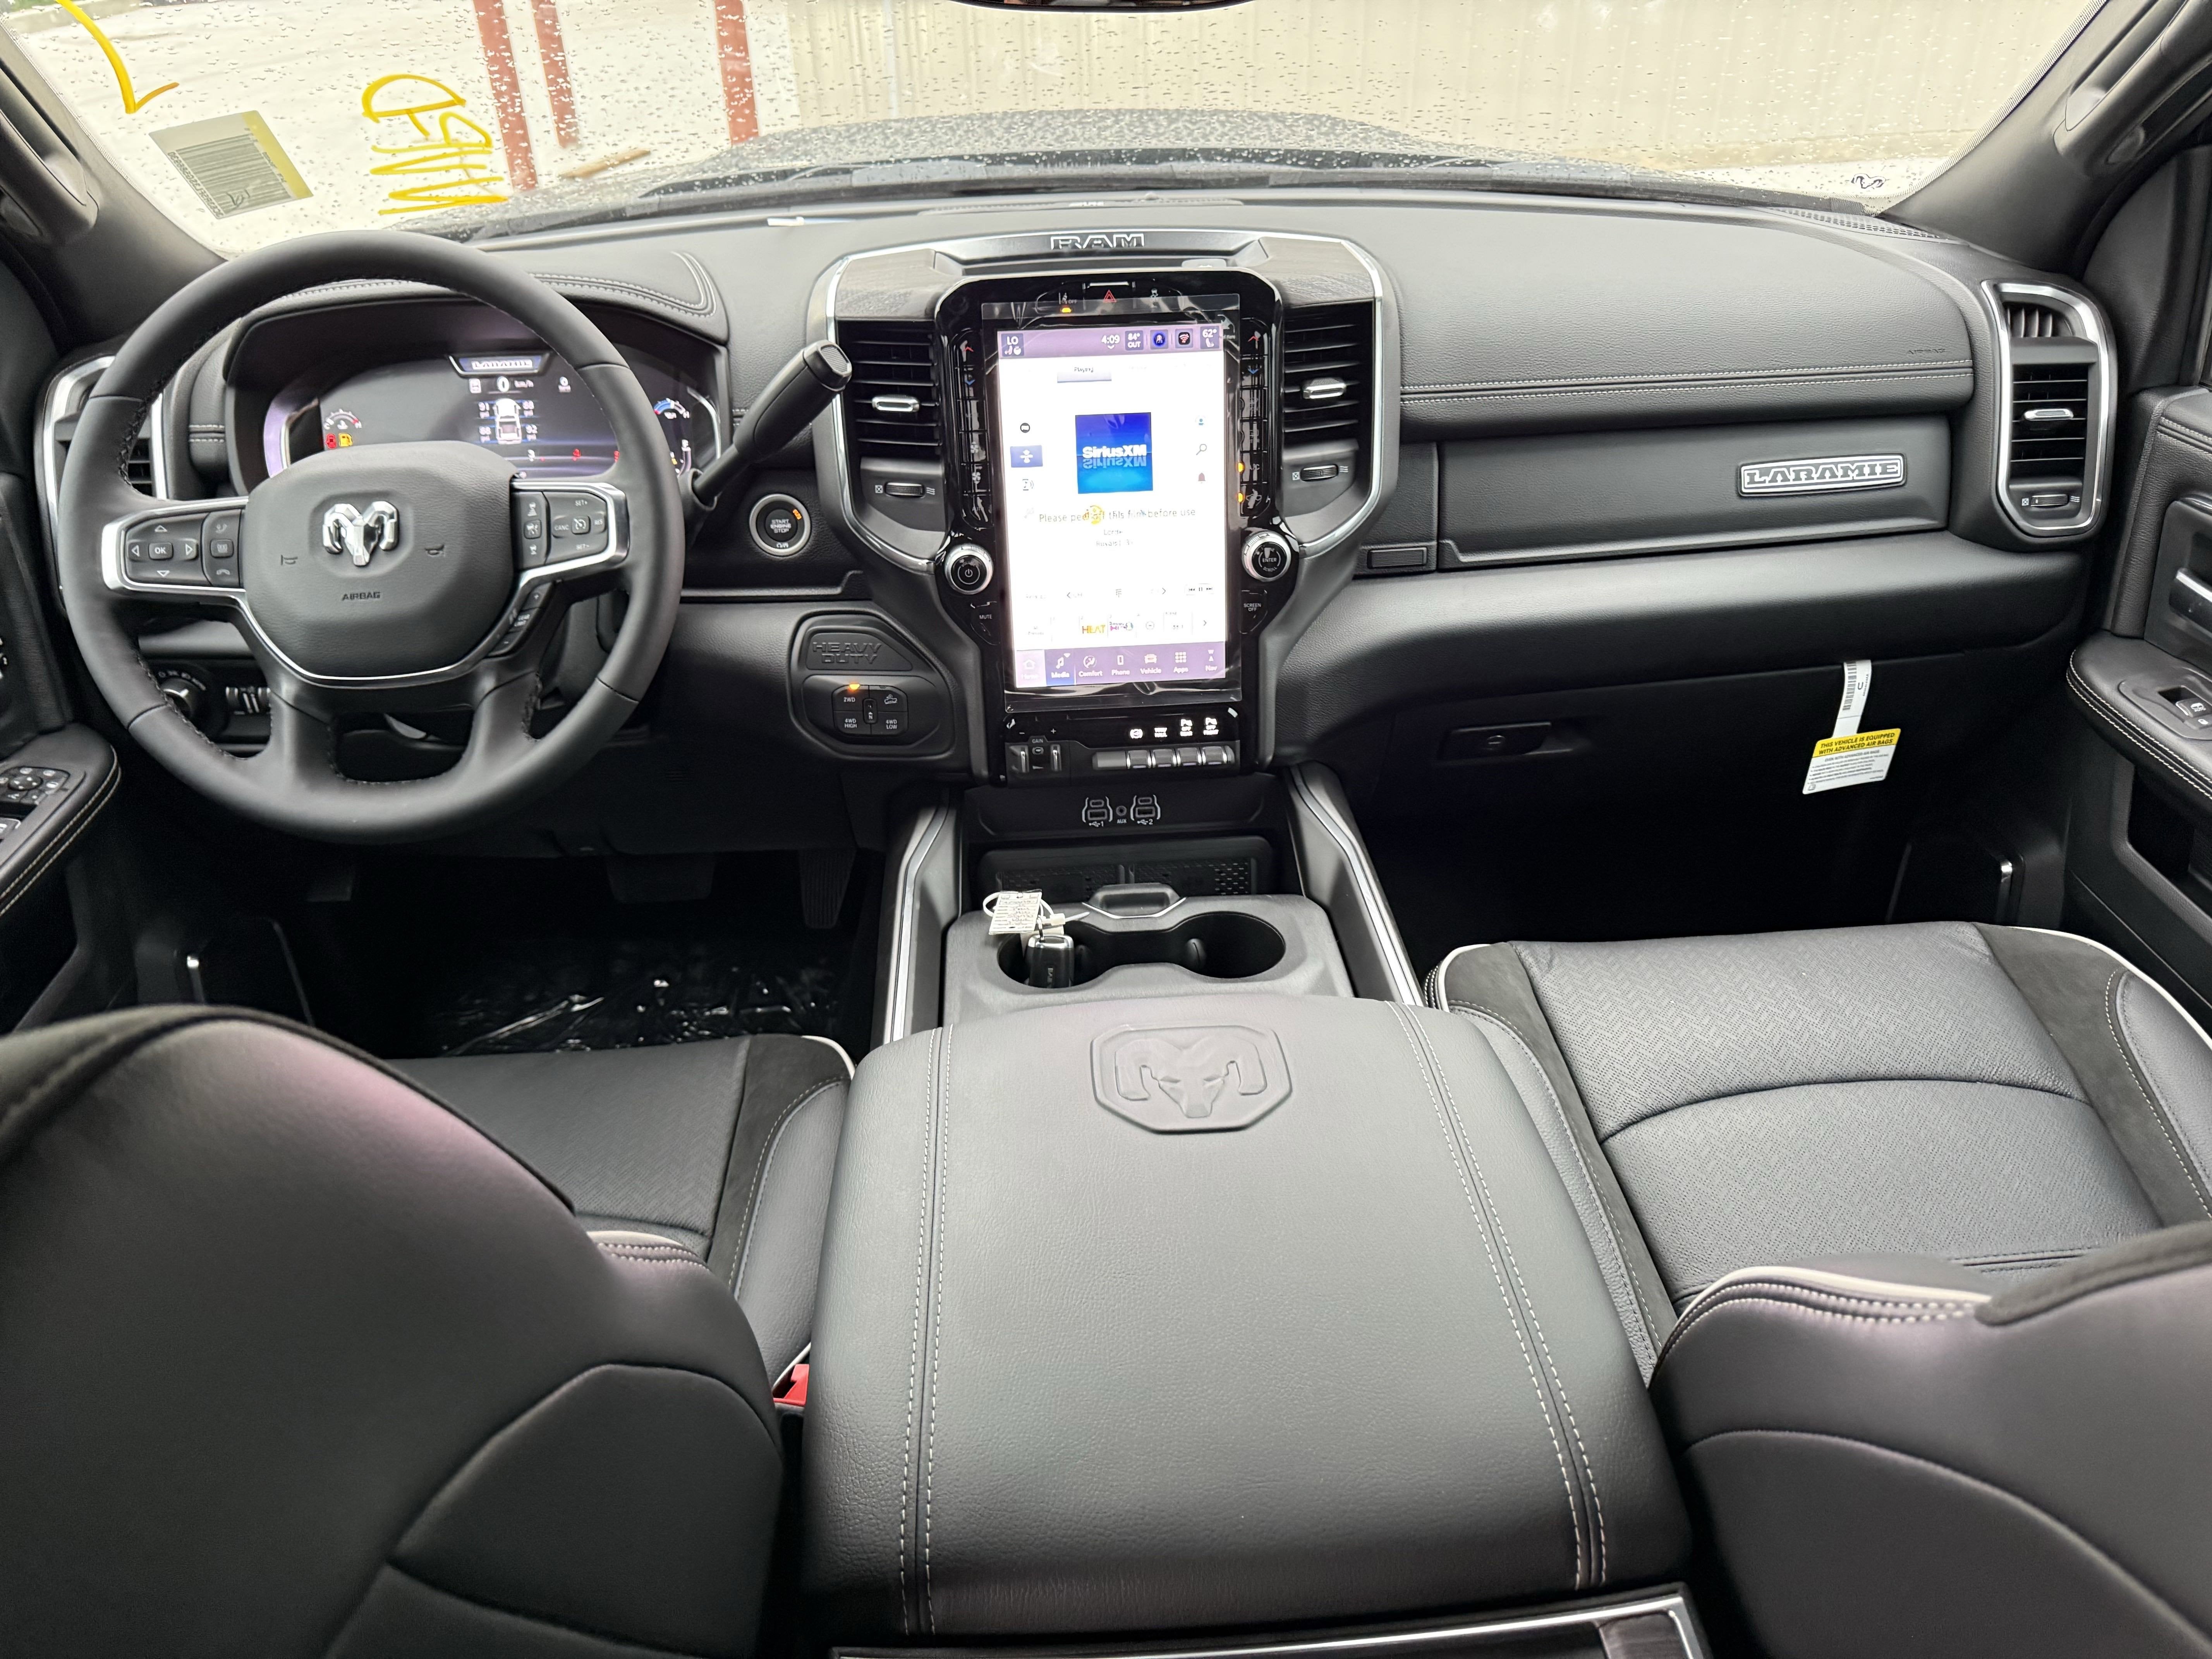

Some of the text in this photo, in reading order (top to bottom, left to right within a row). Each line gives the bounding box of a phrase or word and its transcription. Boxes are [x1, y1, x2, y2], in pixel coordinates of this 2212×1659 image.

[1050, 233, 1145, 250] RAM
[1202, 329, 1217, 338] 62°
[1007, 336, 1019, 345] LO
[1101, 335, 1120, 344] 4:09
[1082, 444, 1147, 459] SiriusXM
[1747, 463, 1899, 485] LARAMIE
[1039, 512, 1067, 522] Please
[341, 591, 381, 601] AIRBAG
[1082, 624, 1105, 634] HEAT
[813, 642, 882, 653] HEAVY
[822, 654, 878, 664] DUTY
[1834, 738, 1858, 746] VEHICLE
[1834, 742, 1865, 752] ADVANCED
